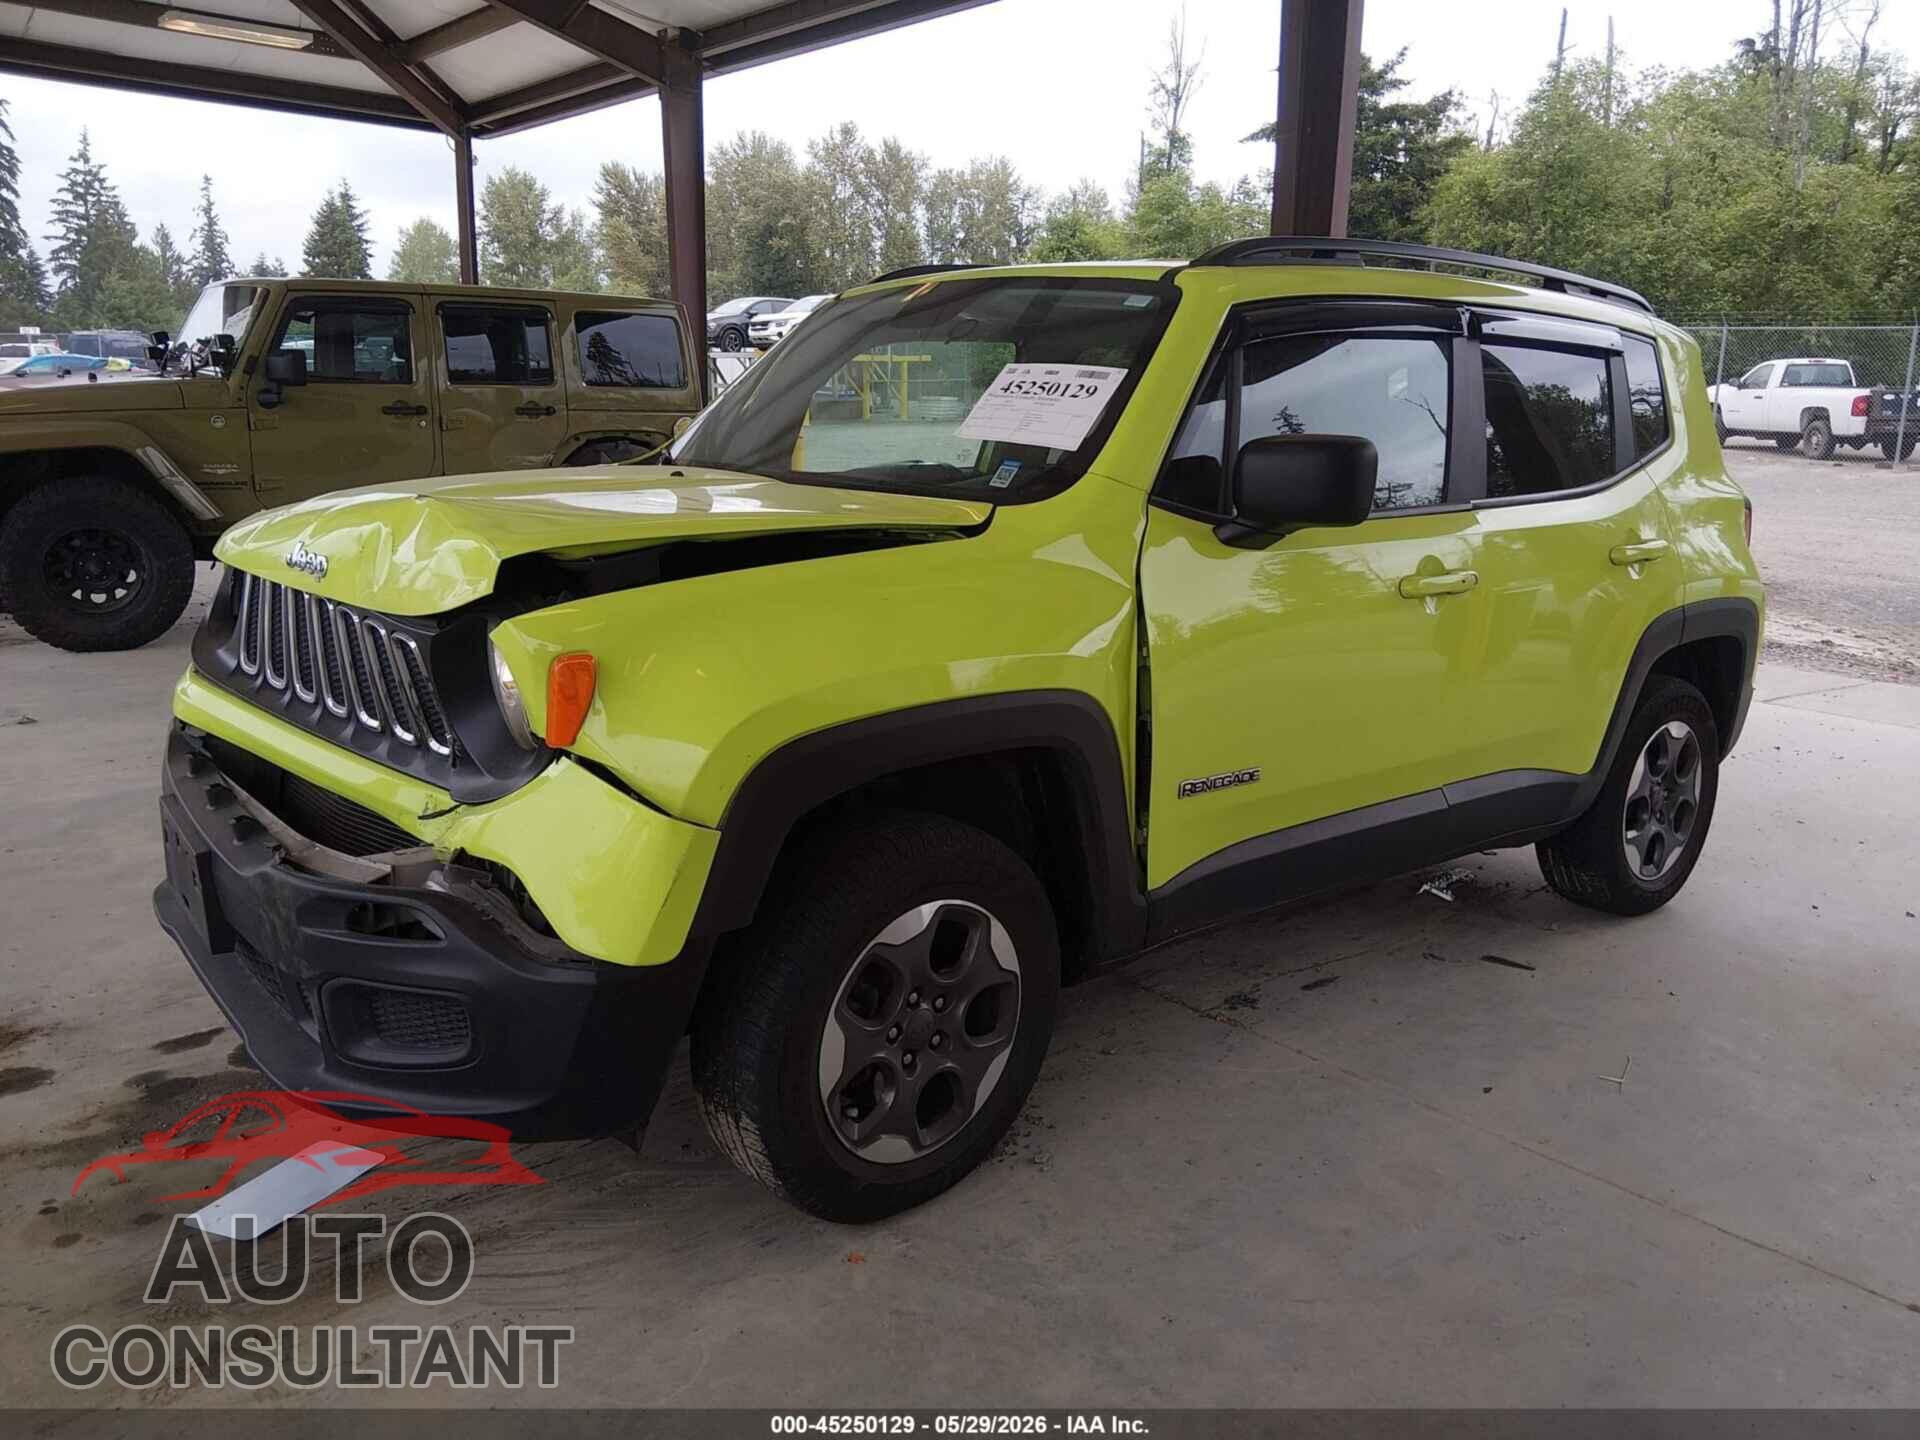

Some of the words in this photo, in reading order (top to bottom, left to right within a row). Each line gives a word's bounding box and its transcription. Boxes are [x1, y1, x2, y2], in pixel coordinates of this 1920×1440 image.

[1000, 379, 1098, 400] 45250129
[286, 540, 329, 583] Jeep
[1177, 767, 1262, 800] RENEGADE
